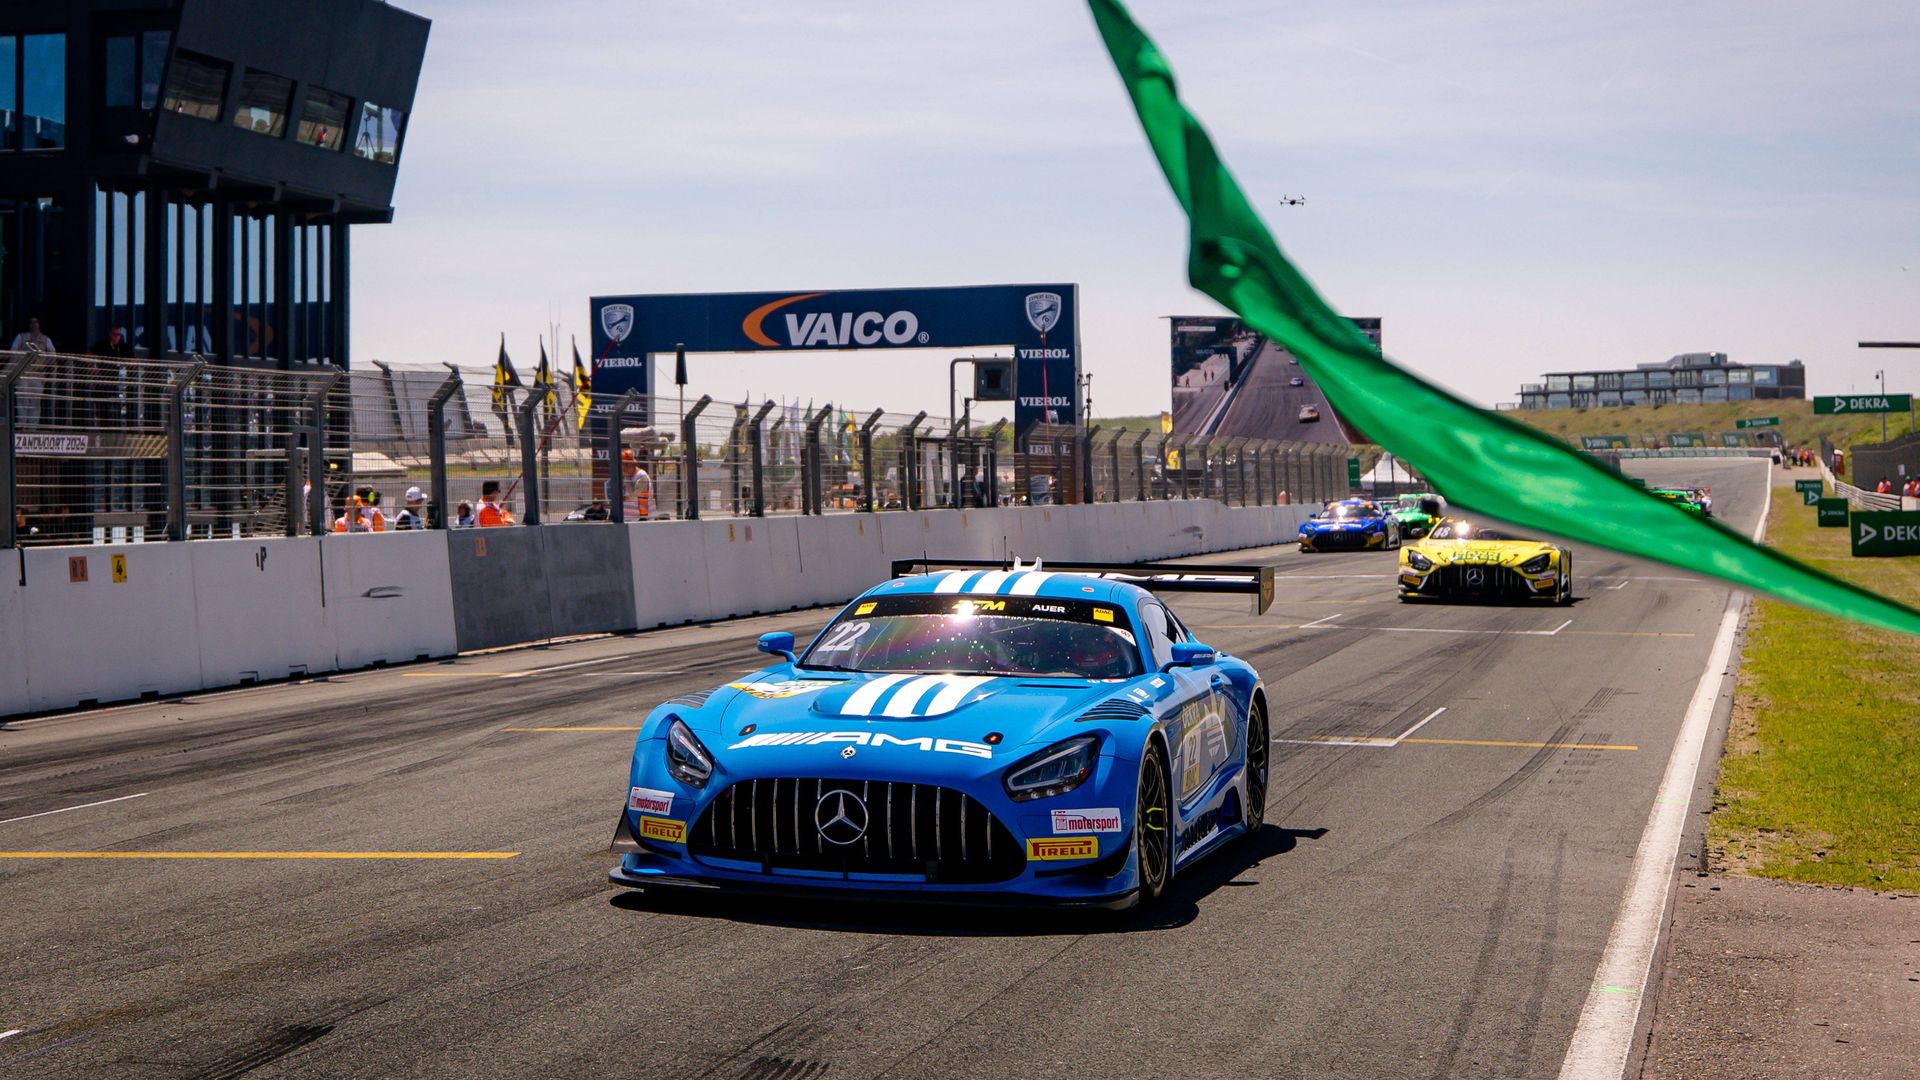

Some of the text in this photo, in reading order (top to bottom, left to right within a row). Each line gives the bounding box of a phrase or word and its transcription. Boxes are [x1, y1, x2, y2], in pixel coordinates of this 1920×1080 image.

[1019, 348, 1070, 359] VIEROL
[595, 357, 642, 368] VIEROL
[1020, 396, 1070, 407] VIEROL
[1850, 398, 1889, 409] DEKRA
[1032, 603, 1066, 614] AUER
[817, 621, 871, 652] 22
[636, 796, 669, 813] motorsport
[643, 819, 683, 839] PIRELLI
[1069, 816, 1119, 831] motorsport
[1033, 840, 1093, 857] PIRELLI
